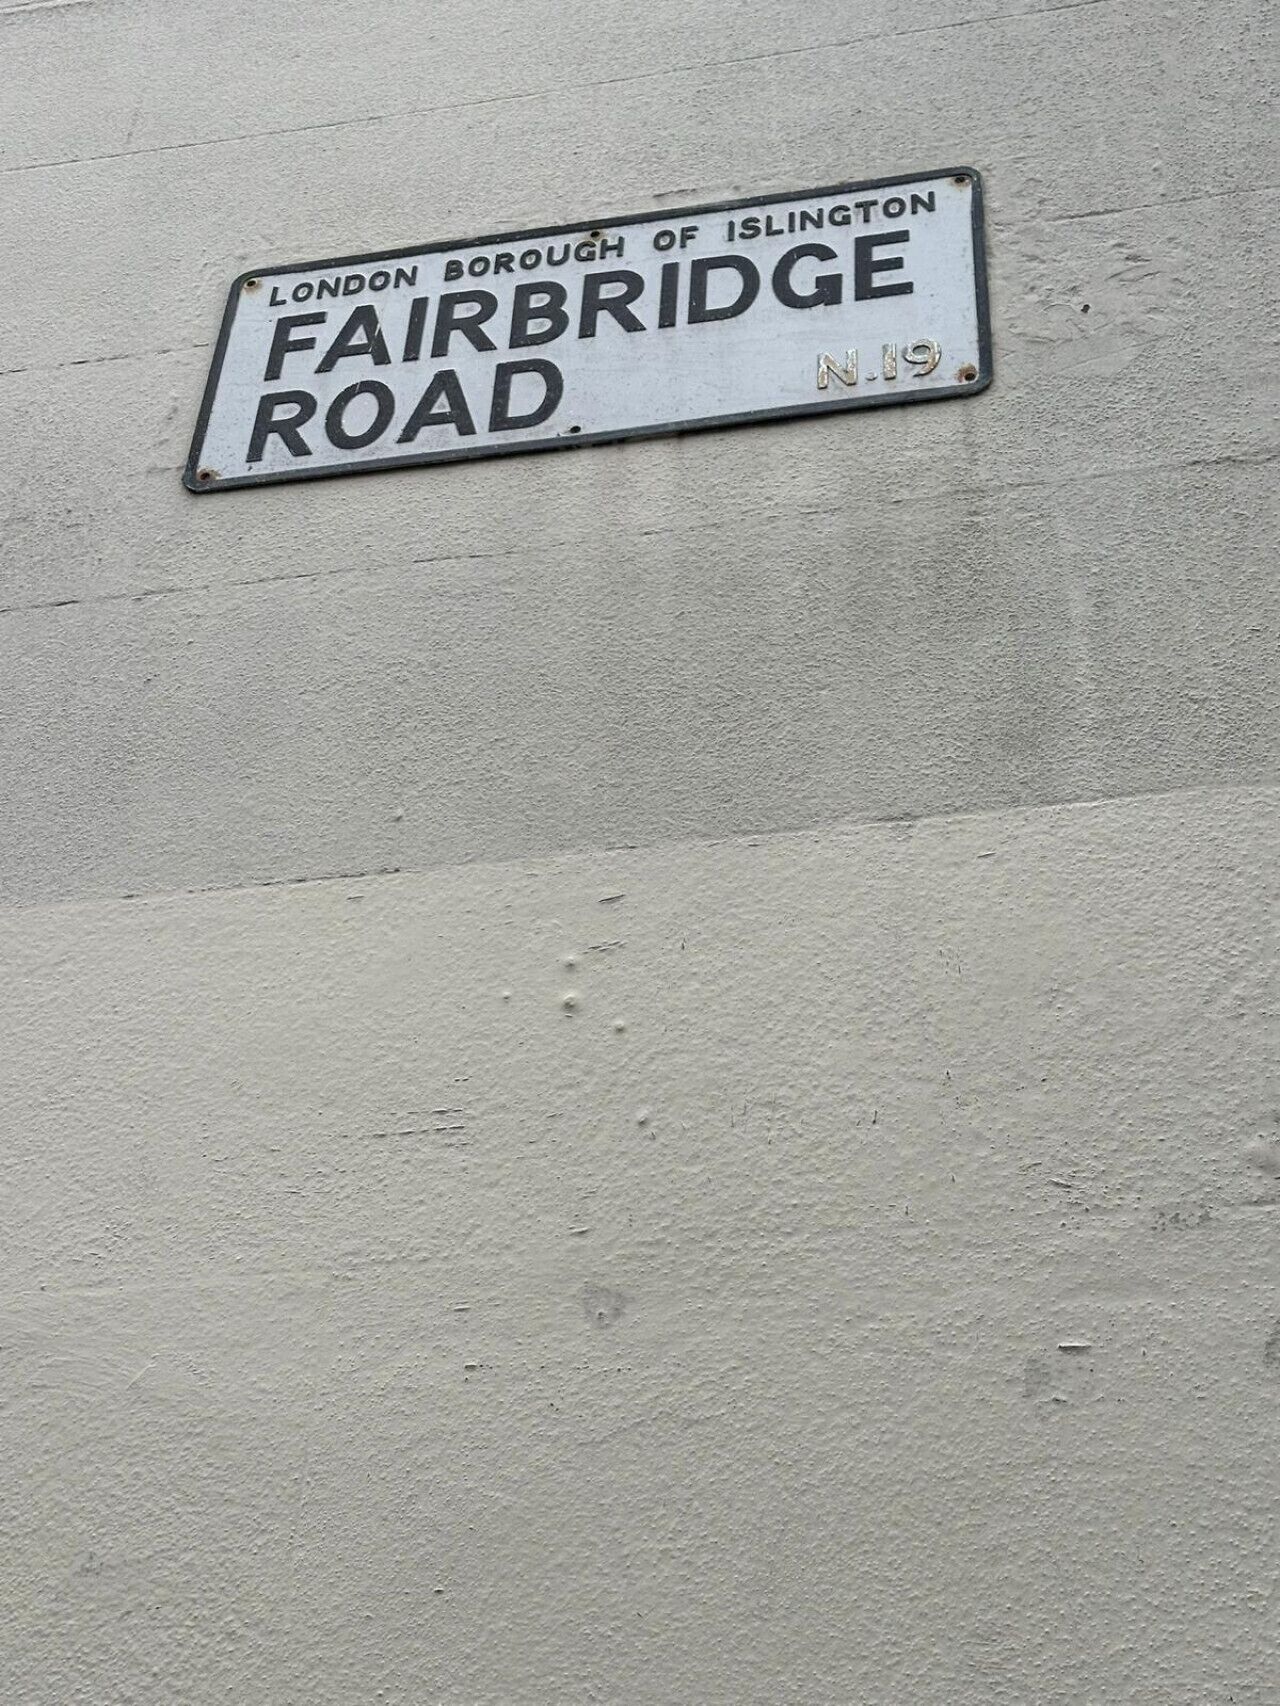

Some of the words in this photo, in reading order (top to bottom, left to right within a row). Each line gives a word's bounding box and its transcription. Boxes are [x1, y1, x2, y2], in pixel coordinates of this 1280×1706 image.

[269, 265, 418, 307] LONDON
[443, 236, 625, 282] BOROUGH
[653, 225, 699, 252] OF
[727, 191, 937, 242] ISLINGTON
[263, 229, 914, 382] FAIRBRIDGE
[245, 358, 564, 464] ROAD
[816, 337, 942, 390] N.19
